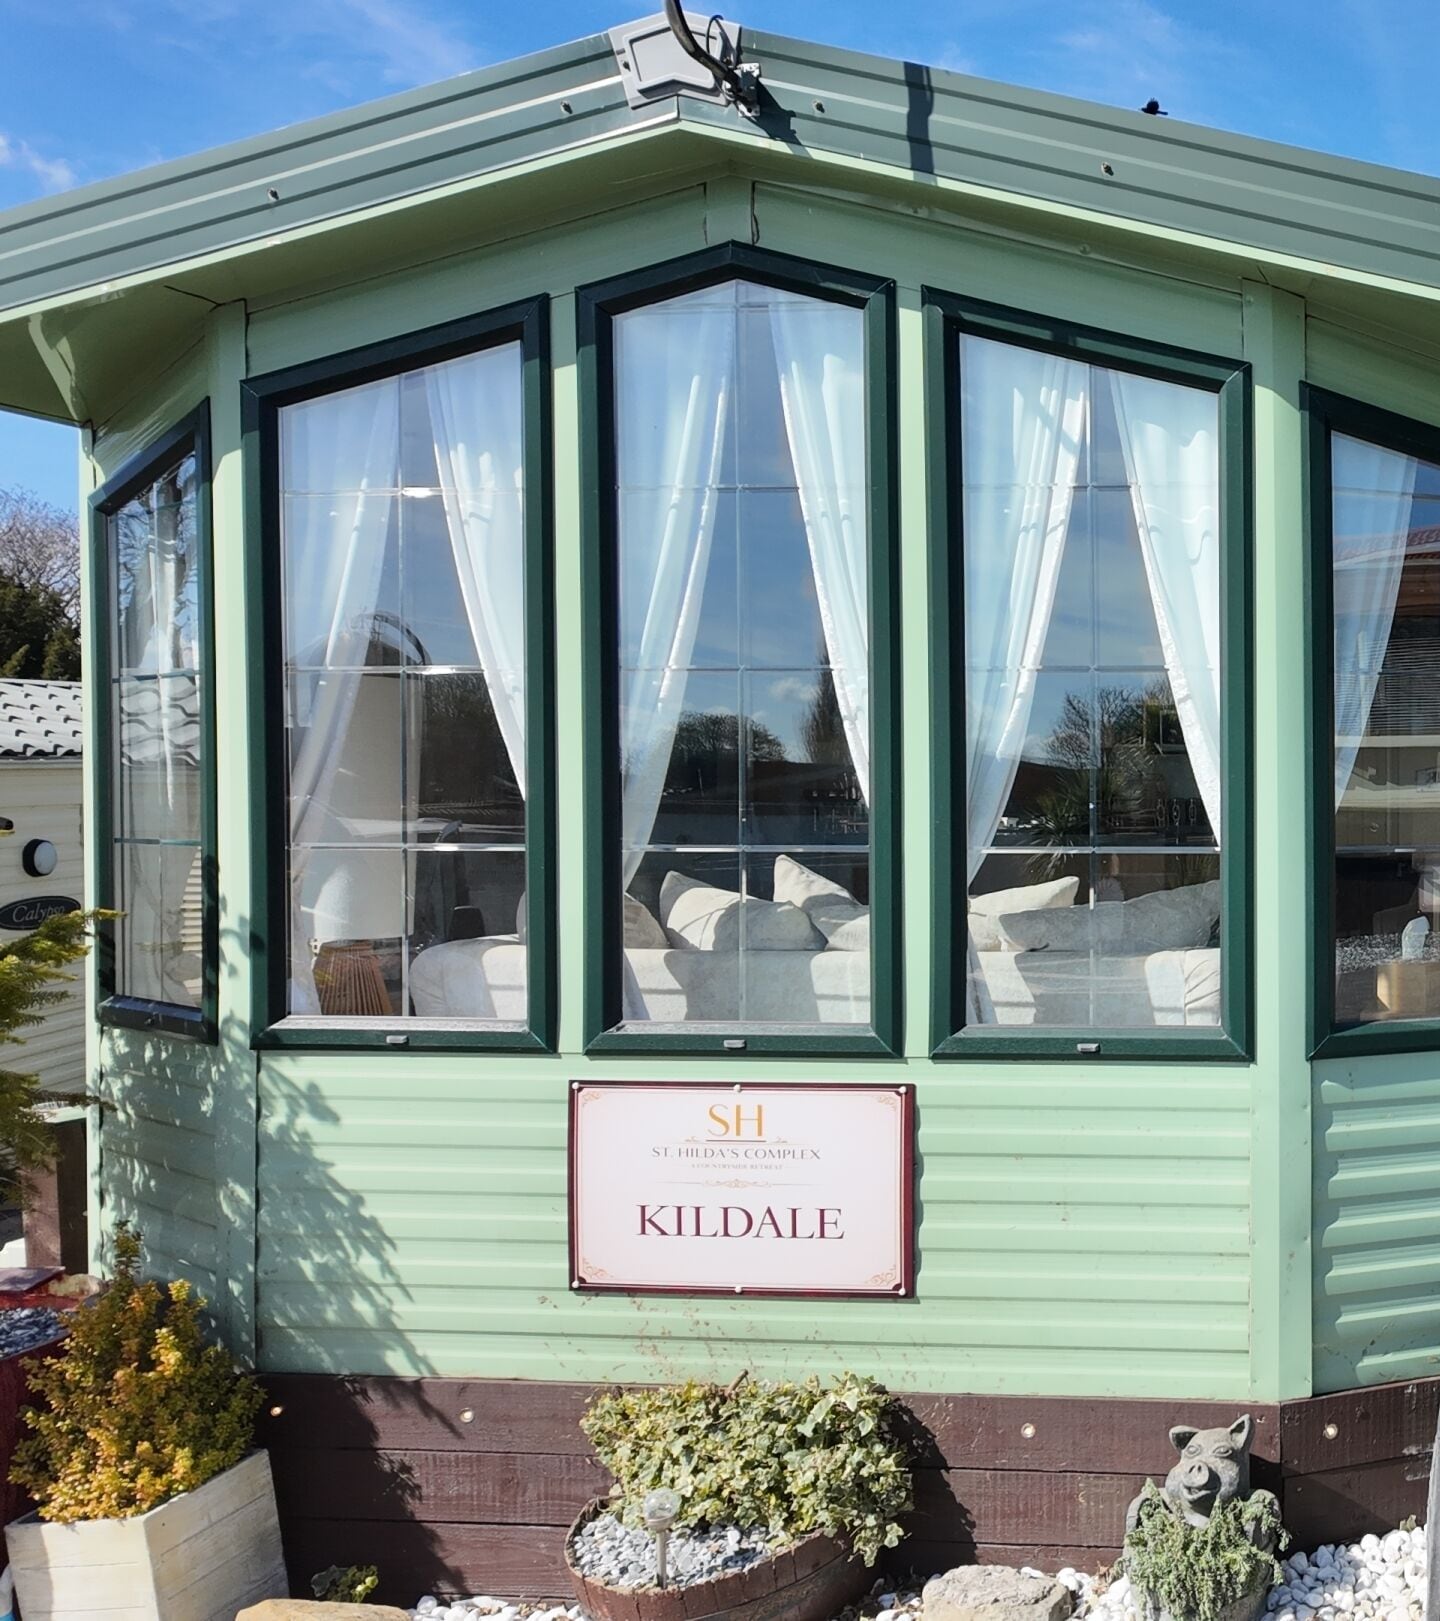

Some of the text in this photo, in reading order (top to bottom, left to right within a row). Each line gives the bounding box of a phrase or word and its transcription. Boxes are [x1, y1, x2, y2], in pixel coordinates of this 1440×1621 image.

[12, 902, 65, 923] Calypso
[707, 1103, 763, 1137] SH
[651, 1146, 821, 1160] ST. HILDA'S COMPLEX
[636, 1205, 845, 1239] KILDALE
